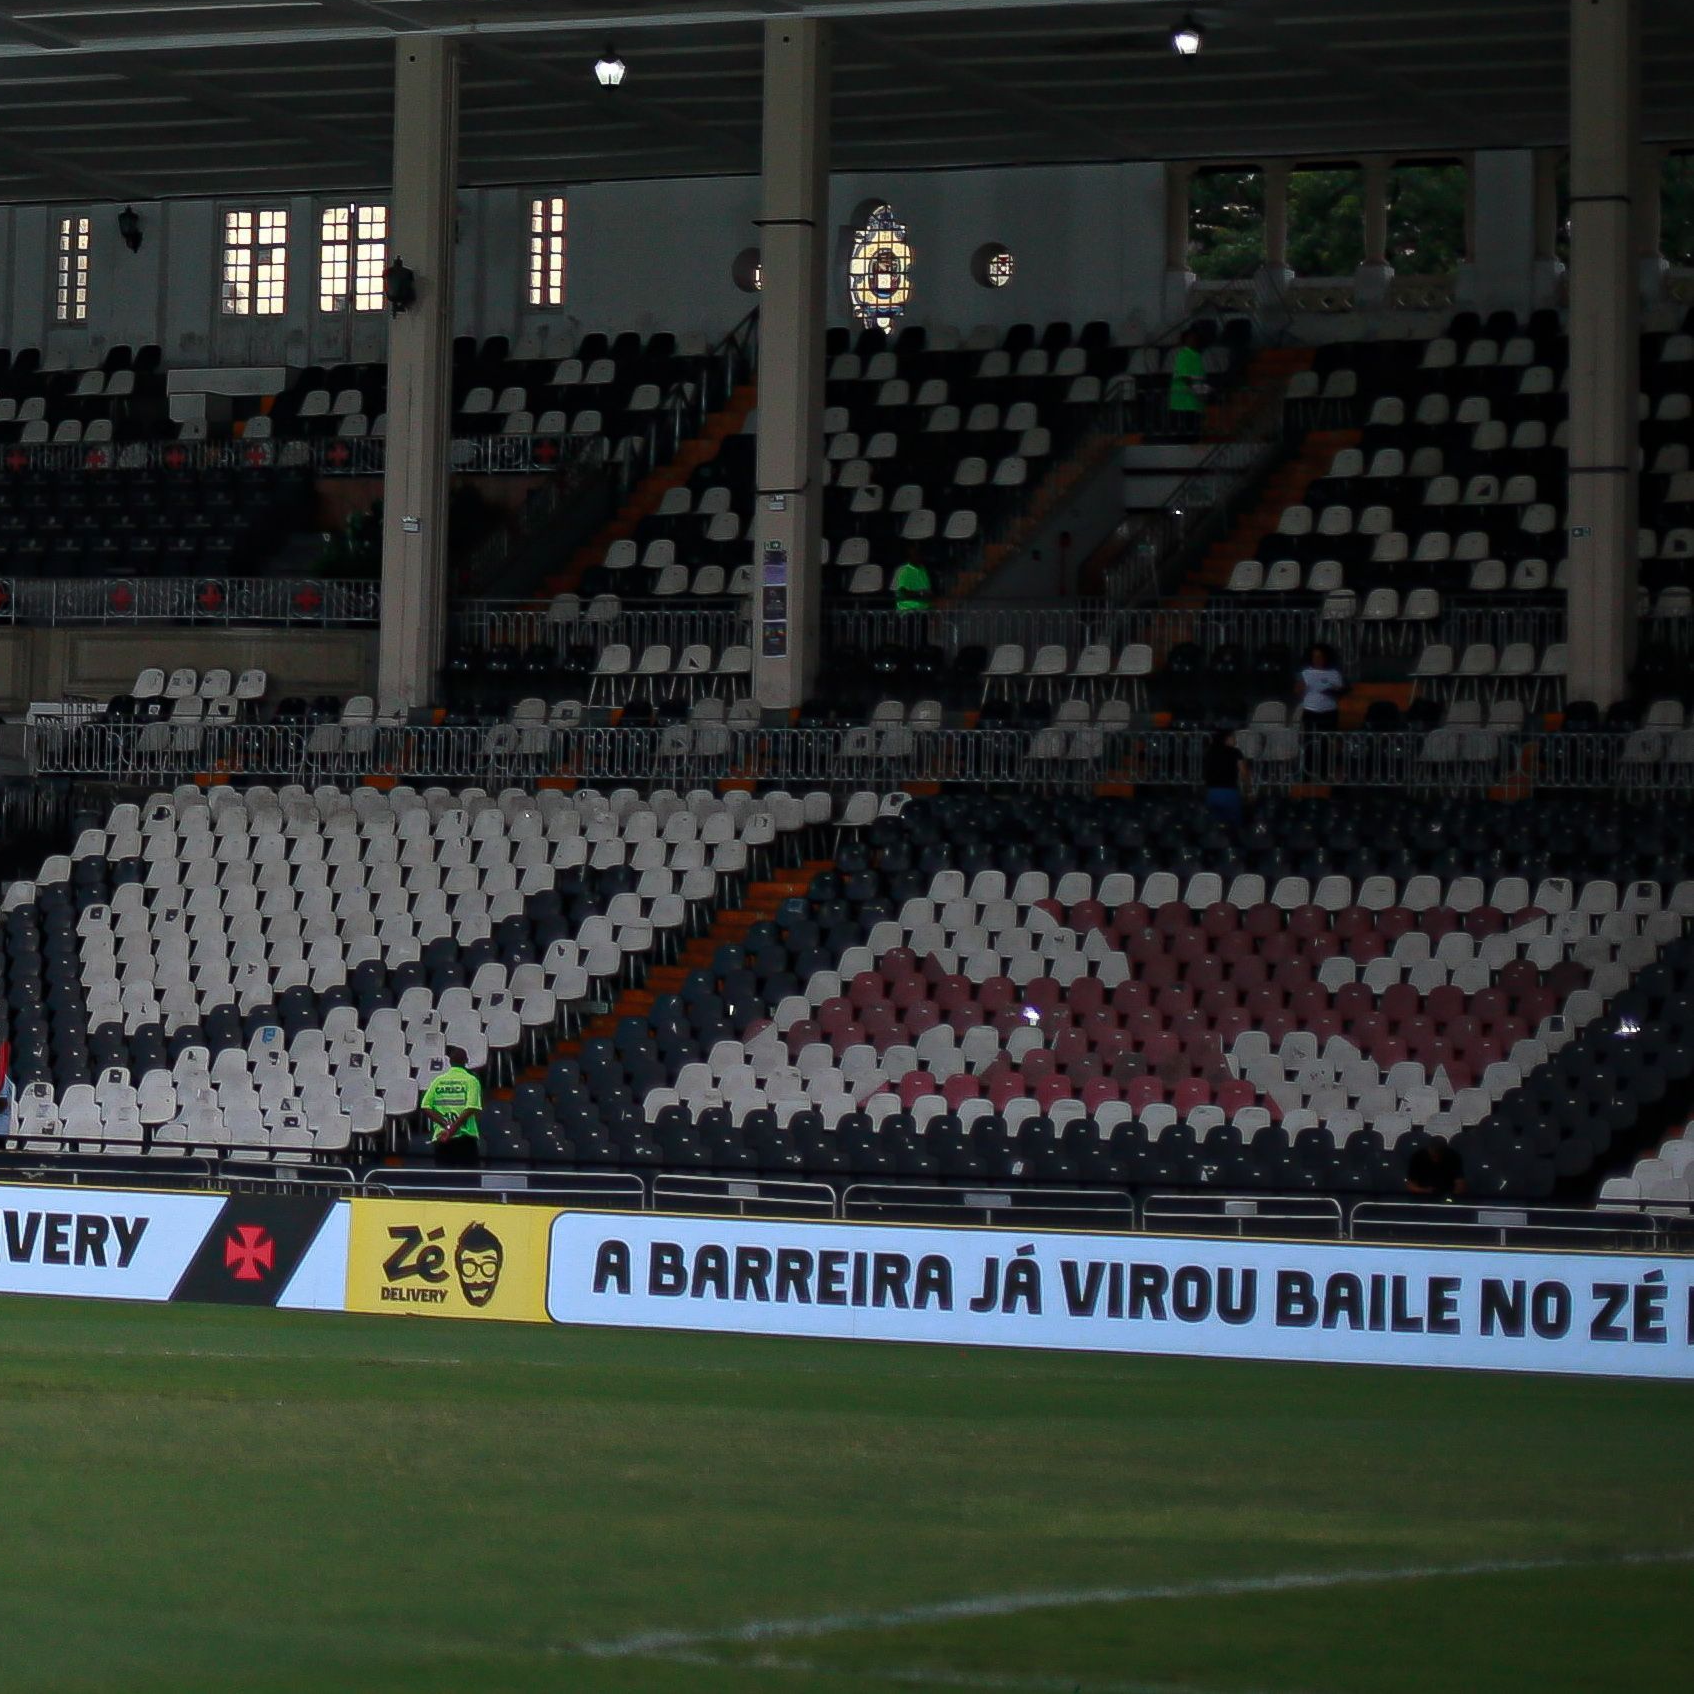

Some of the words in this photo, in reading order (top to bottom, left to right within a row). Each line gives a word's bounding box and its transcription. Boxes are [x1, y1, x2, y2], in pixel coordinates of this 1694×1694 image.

[382, 1225, 451, 1283] Zé
[380, 1286, 449, 1303] DELIVERY
[592, 1239, 632, 1296] A
[647, 1241, 954, 1312] BARREIRA
[968, 1243, 1044, 1316] JÁ
[1058, 1259, 1260, 1326] VIROU
[1273, 1269, 1463, 1335] BAILE
[1479, 1277, 1575, 1341] NO
[1589, 1268, 1670, 1344] ZÉ
